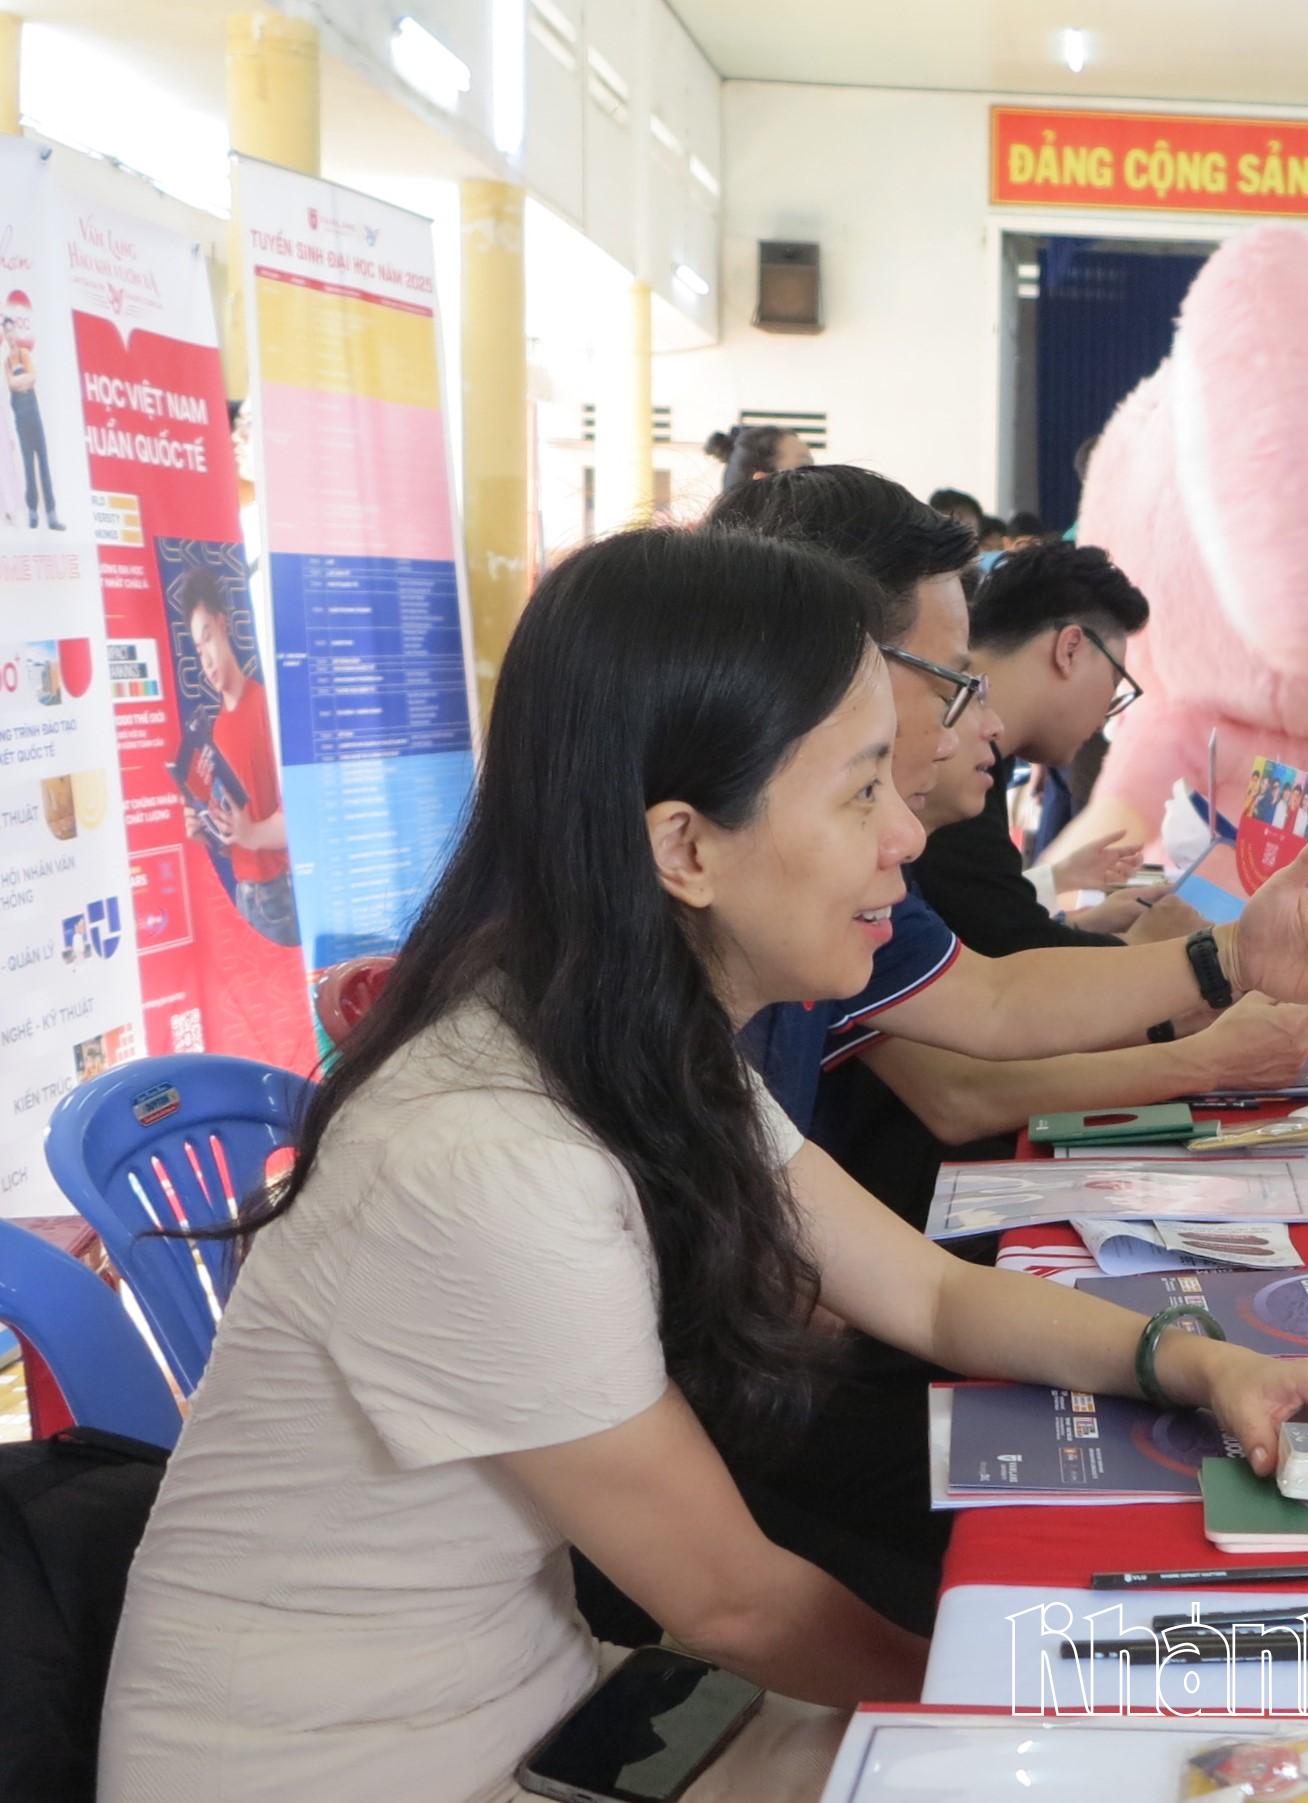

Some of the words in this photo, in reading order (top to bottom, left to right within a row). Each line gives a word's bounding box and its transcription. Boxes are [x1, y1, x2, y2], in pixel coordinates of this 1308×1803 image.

[1008, 129, 1114, 187] ĐẢNG
[1124, 139, 1227, 198] CỘNG
[250, 229, 292, 257] TUYỂN
[295, 240, 324, 265] SINH
[352, 255, 376, 279] HỌC
[405, 270, 434, 294] 2025
[84, 371, 126, 412] HỌC
[124, 378, 164, 421] VIỆT
[165, 390, 209, 425] NAM
[84, 417, 135, 461] HUẨN
[134, 428, 184, 469] QUỐC
[182, 436, 207, 473] TẾ
[93, 512, 121, 524] VERSITY
[1, 804, 39, 828] THUẬT
[13, 1088, 40, 1115] KIẾN
